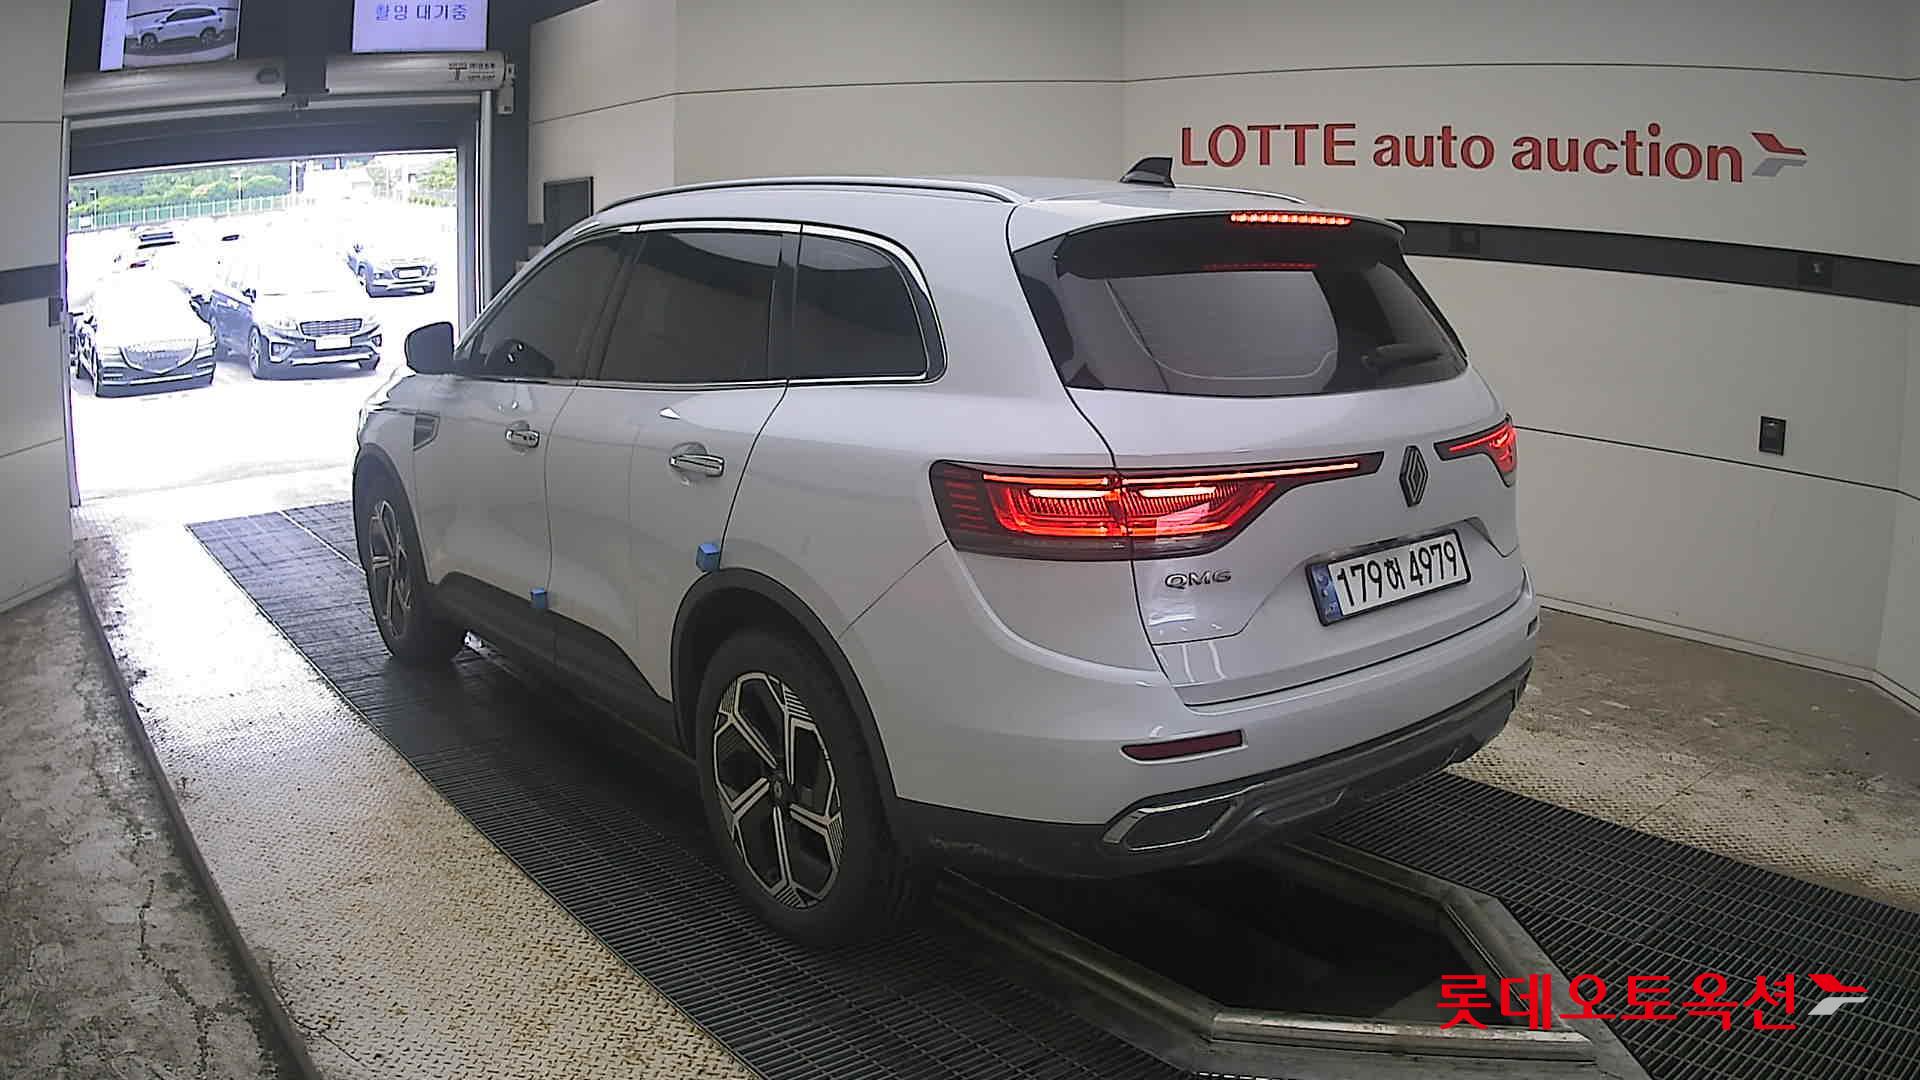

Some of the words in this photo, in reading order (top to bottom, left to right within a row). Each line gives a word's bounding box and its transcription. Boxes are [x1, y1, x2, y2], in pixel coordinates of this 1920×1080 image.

[416, 3, 467, 21] 대기중
[1182, 123, 1356, 167] LOTTE
[1373, 125, 1496, 170] auto
[1512, 122, 1743, 183] auction
[1164, 570, 1232, 590] QM6
[1408, 541, 1459, 587] 4979
